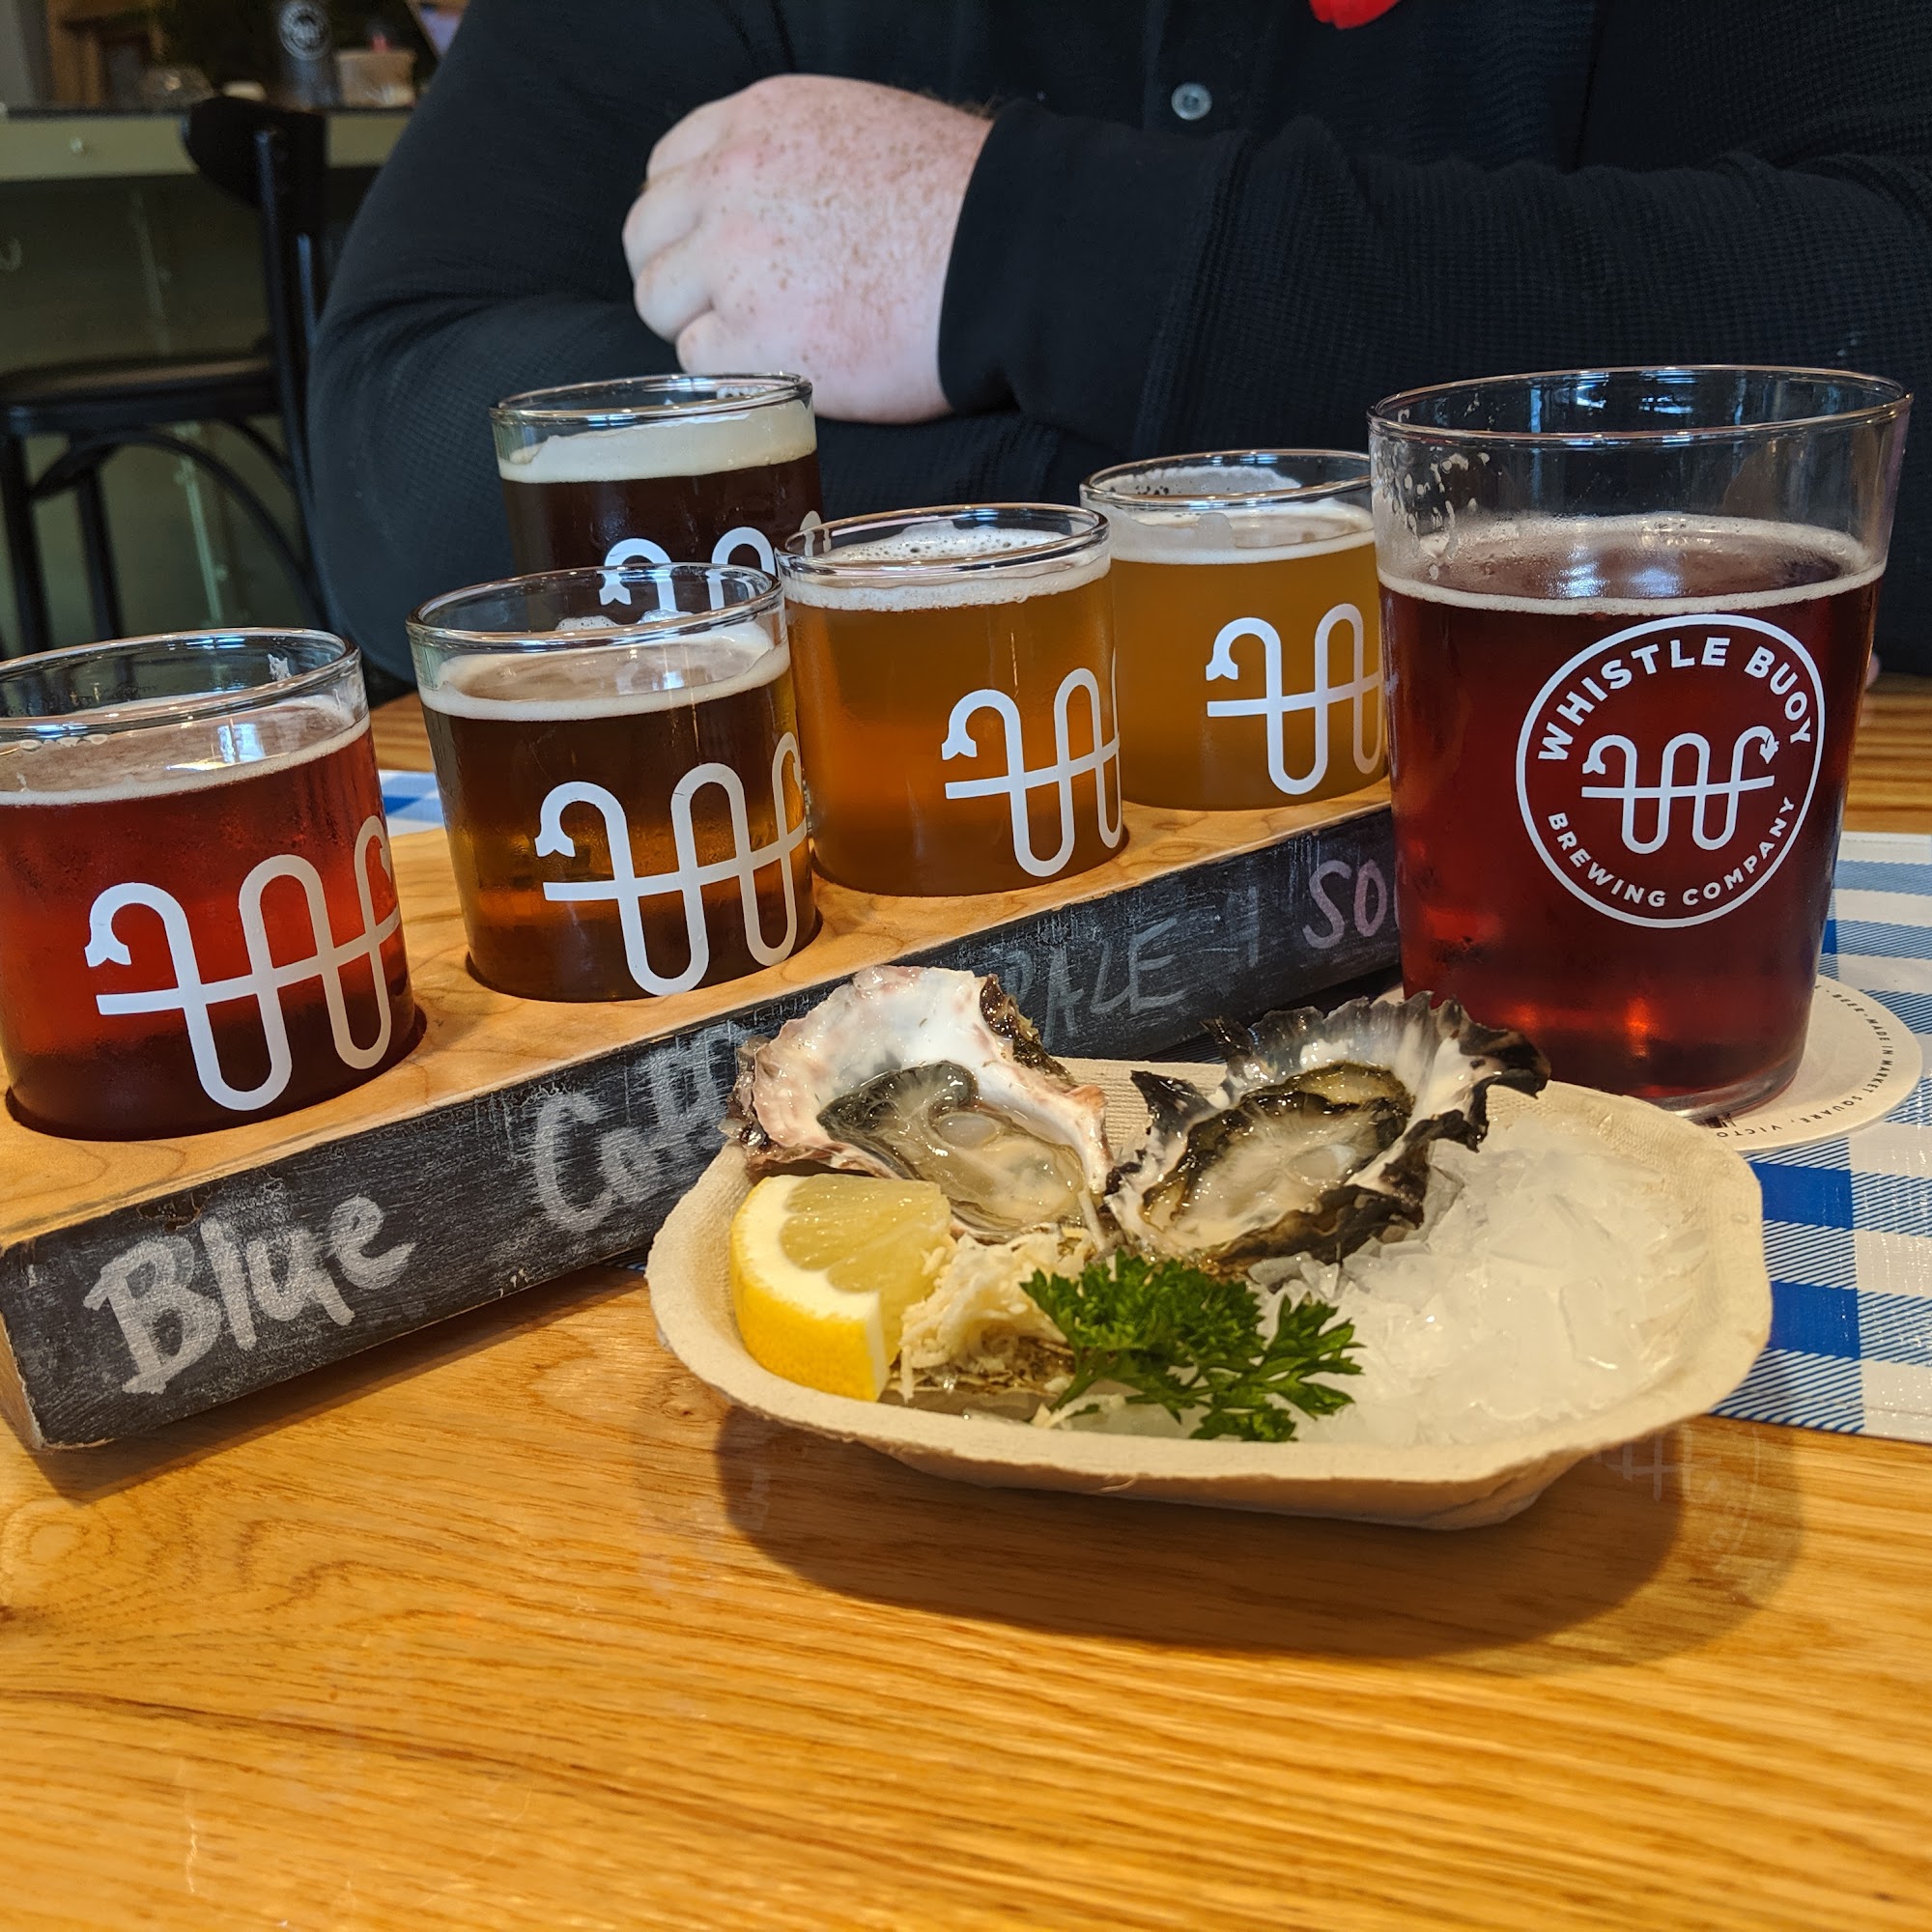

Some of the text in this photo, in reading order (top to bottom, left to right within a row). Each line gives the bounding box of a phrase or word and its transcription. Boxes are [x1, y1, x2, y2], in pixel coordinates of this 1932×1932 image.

[1538, 637, 1811, 761] WHISTLE BUOY
[1548, 796, 1796, 908] BREWING COMPANY
[1302, 859, 1400, 949] SO
[1865, 1017, 1891, 1041] MADE
[1881, 1045, 1893, 1055] IN
[1861, 1059, 1893, 1094] MARKET
[83, 1194, 416, 1395] Blue
